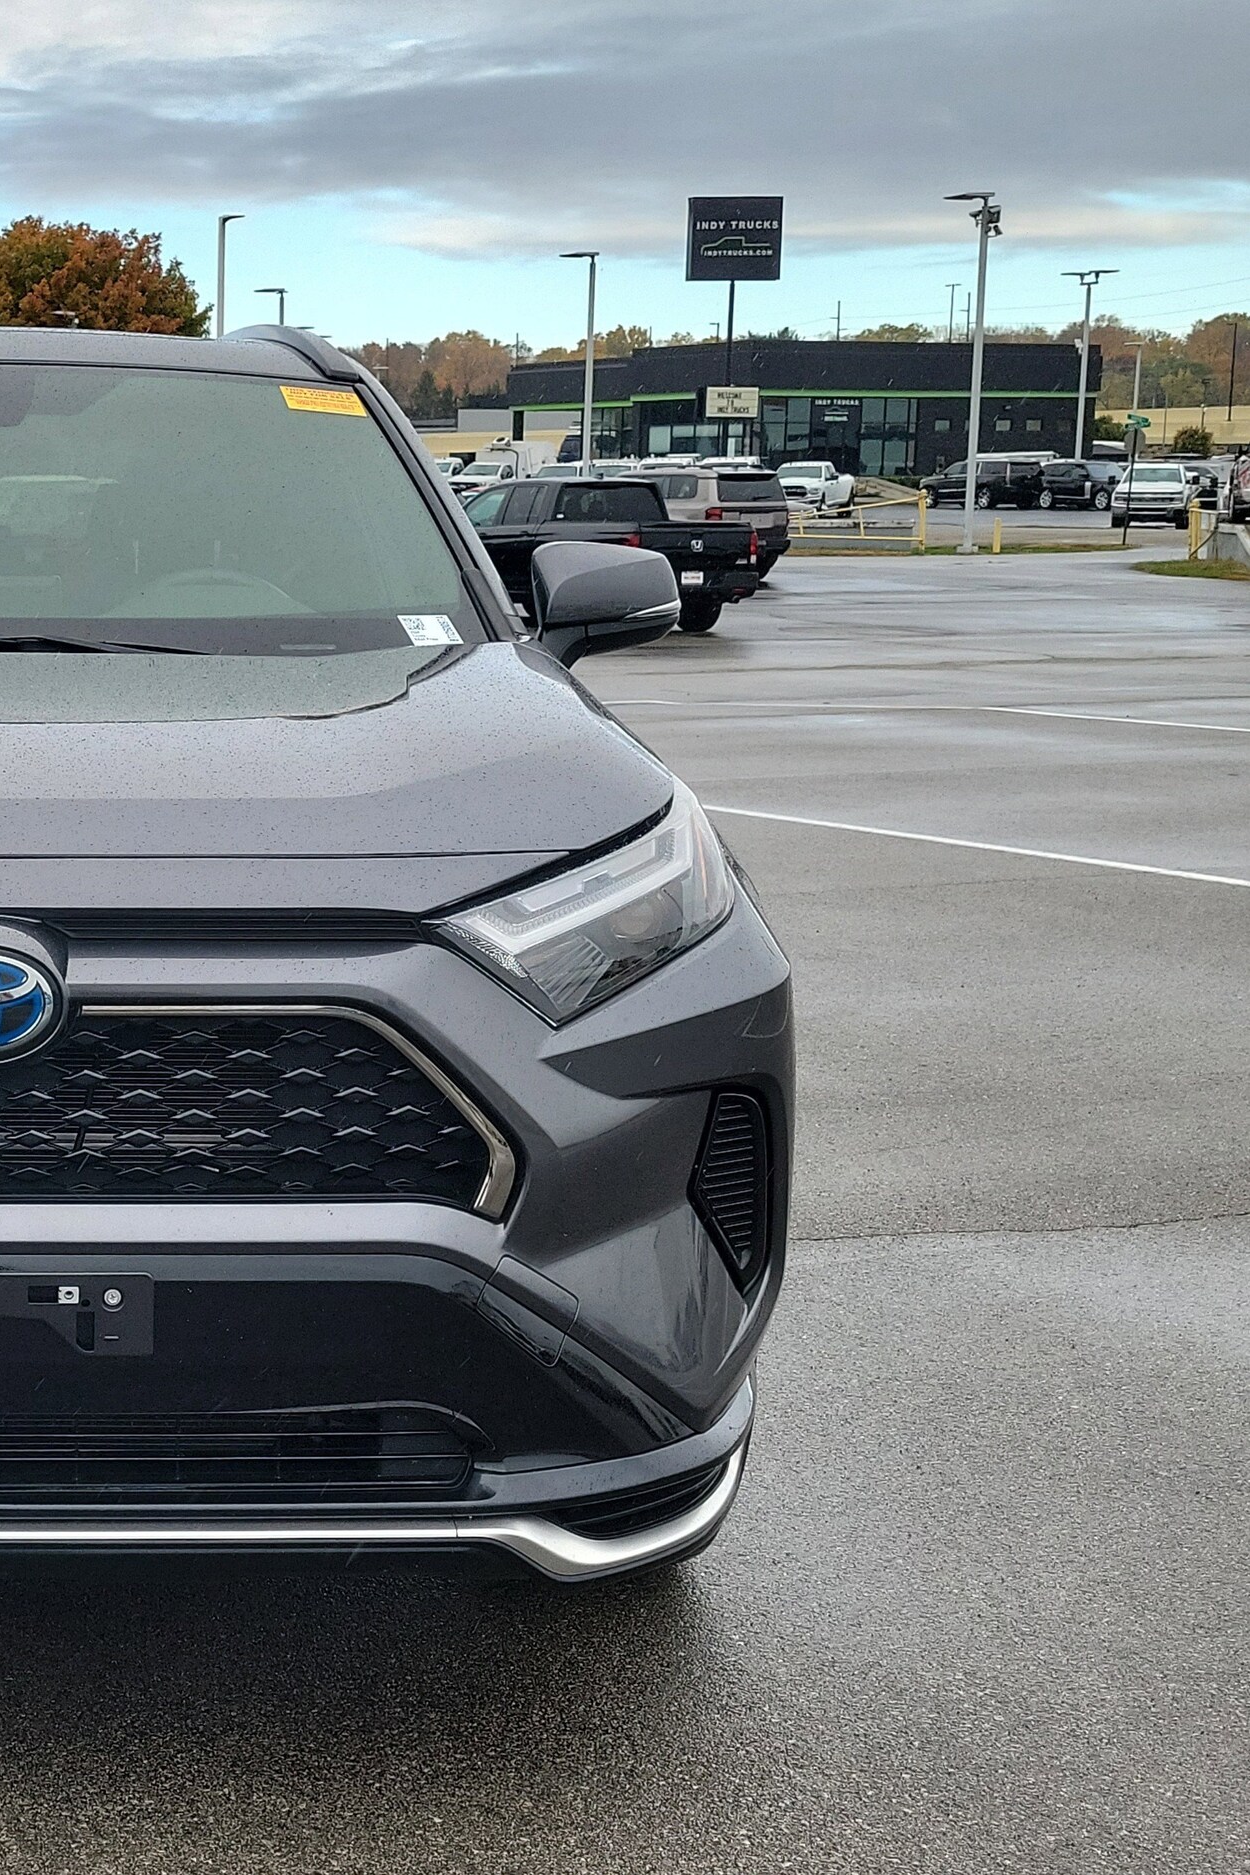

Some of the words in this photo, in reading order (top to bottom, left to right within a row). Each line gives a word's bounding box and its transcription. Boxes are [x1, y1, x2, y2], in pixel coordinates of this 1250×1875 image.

[696, 221, 725, 230] INDY
[730, 220, 779, 230] TRUCKS
[703, 249, 773, 257] INDYTRUCKS.COM
